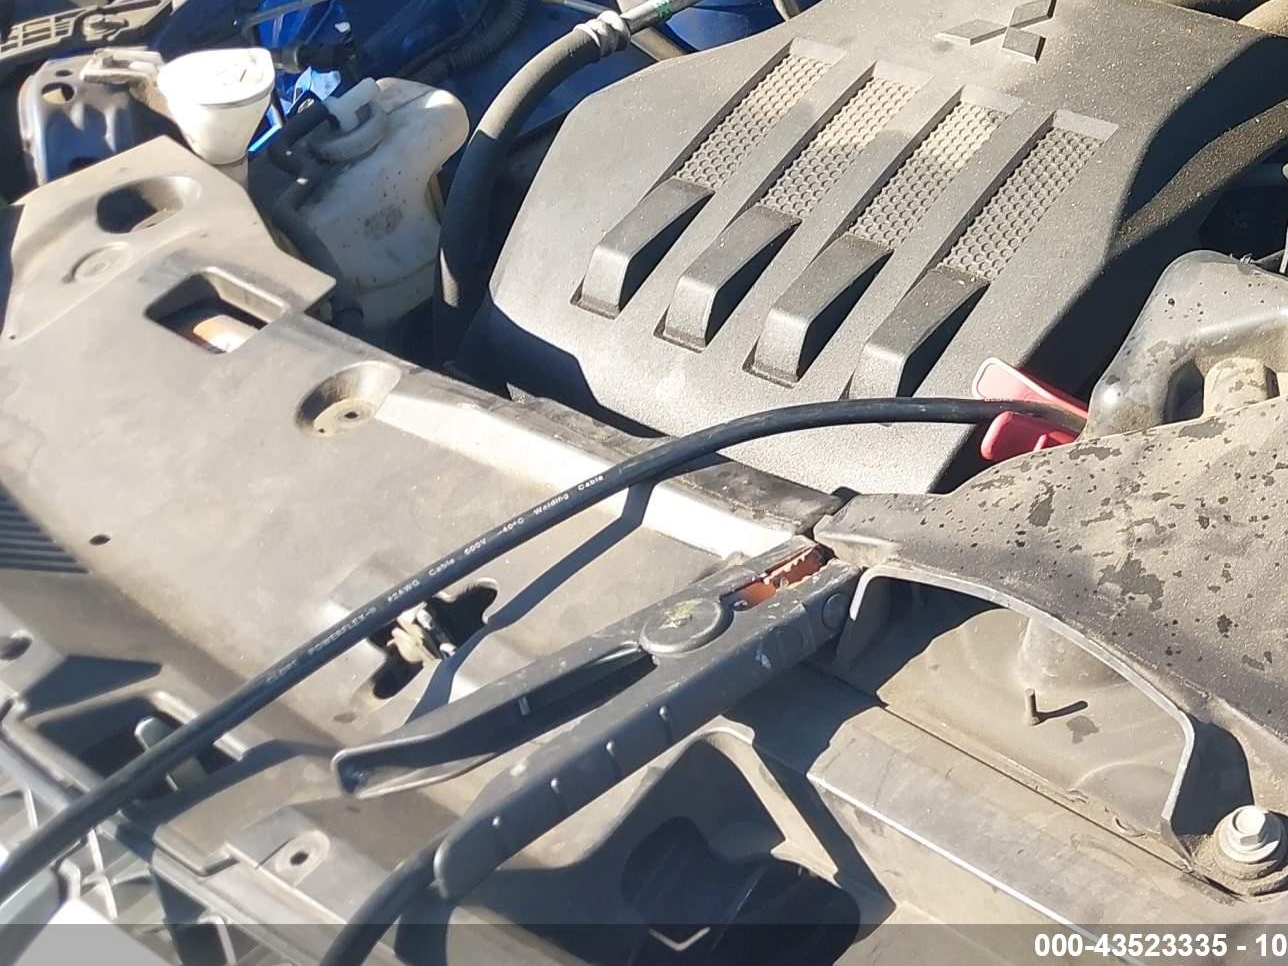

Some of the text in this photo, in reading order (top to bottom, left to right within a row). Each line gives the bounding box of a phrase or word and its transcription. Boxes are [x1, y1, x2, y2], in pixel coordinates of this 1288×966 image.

[428, 558, 455, 576] Cable
[464, 537, 487, 555] 600V
[533, 493, 570, 515] Welding
[577, 475, 604, 491] Cable
